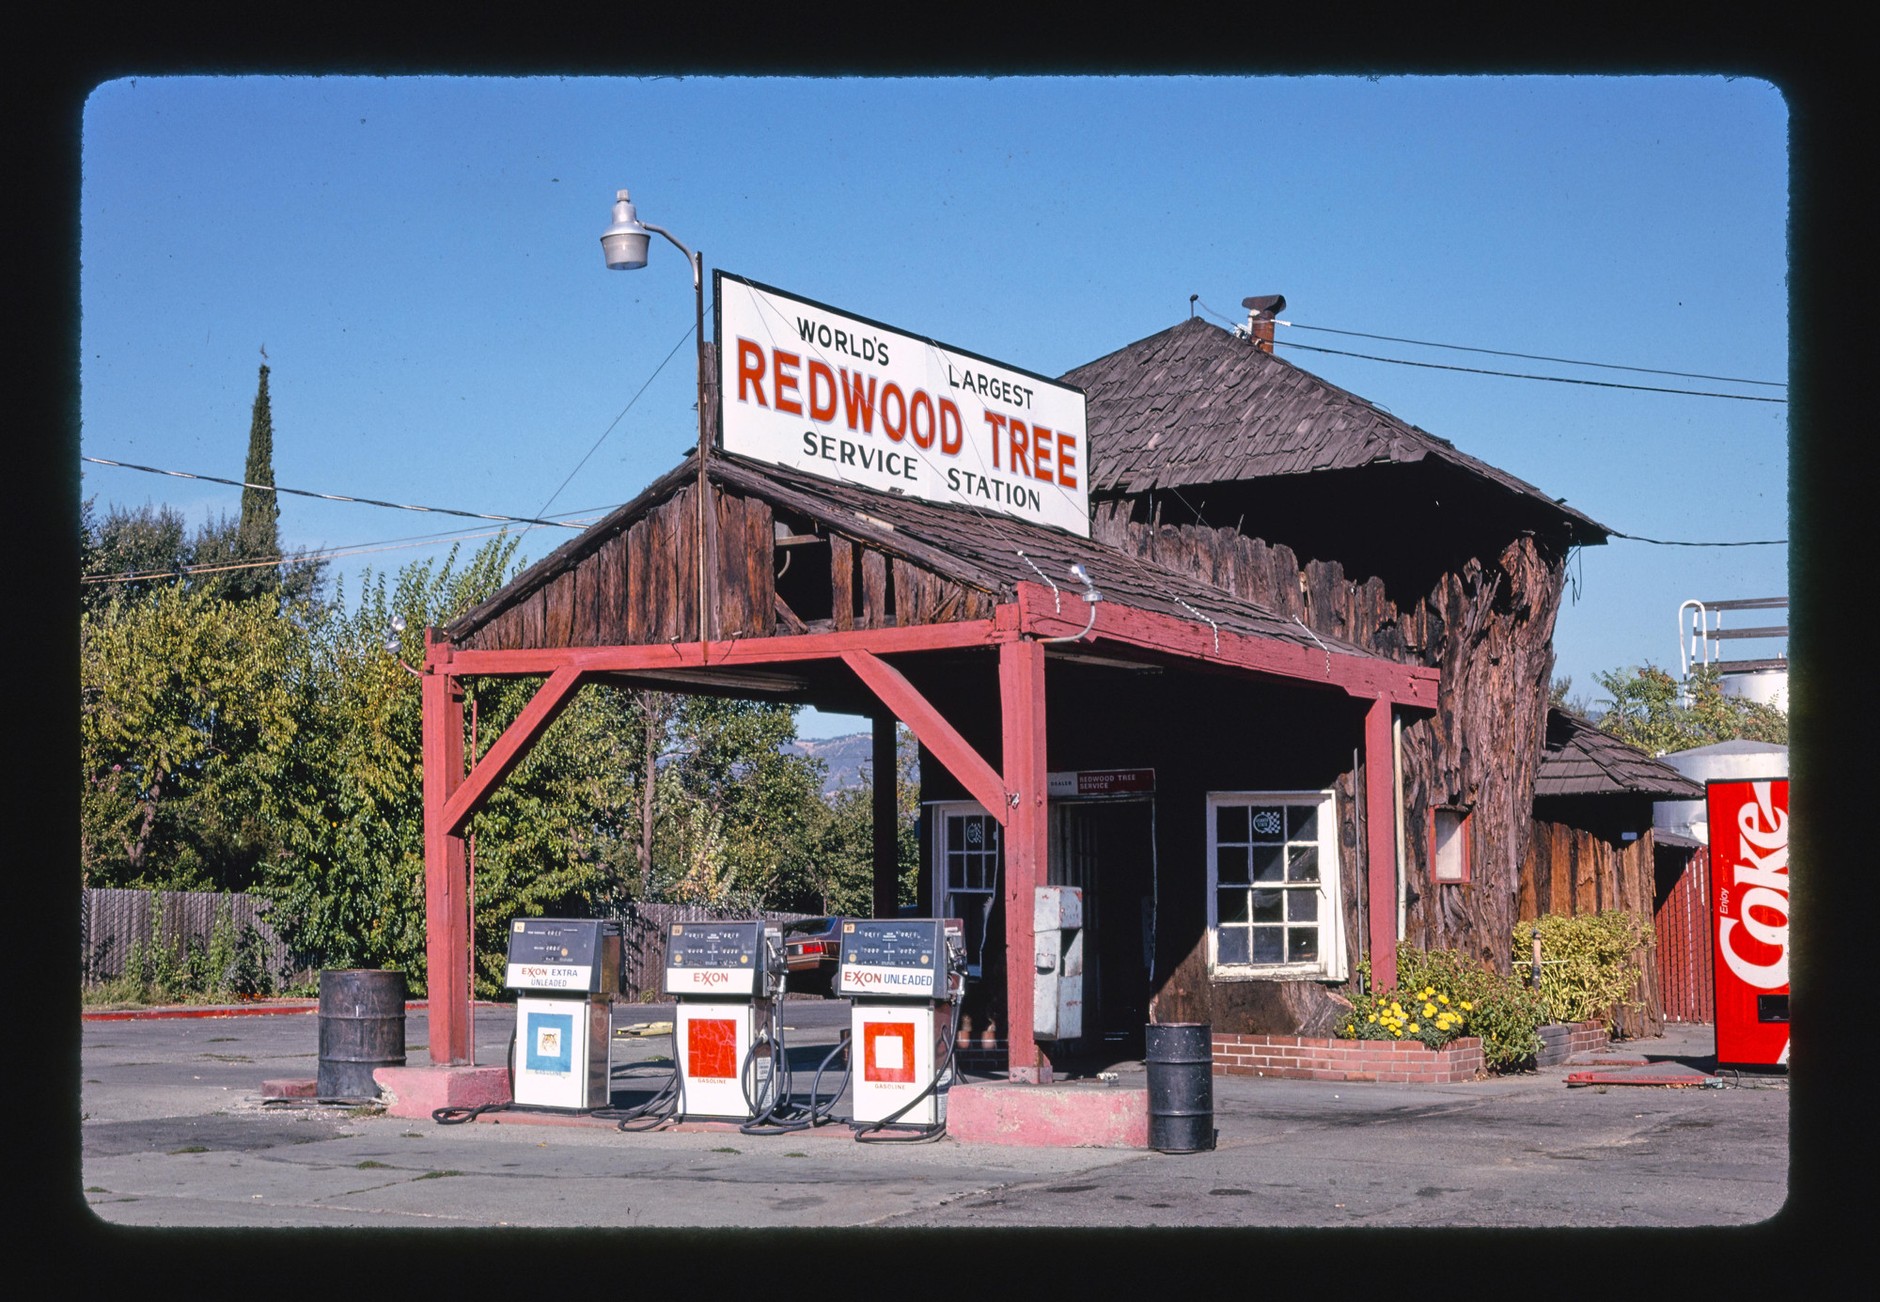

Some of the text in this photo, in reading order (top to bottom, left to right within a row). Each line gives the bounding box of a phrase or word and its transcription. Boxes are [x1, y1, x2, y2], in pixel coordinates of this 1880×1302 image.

[797, 317, 1033, 409] WORLD'S LARGEST
[736, 336, 1078, 489] REDWOOD TREE
[803, 431, 1041, 513] SERVICE STATION
[1080, 775, 1115, 783] REDWOOD
[1719, 782, 1789, 989] Coke
[1719, 887, 1730, 914] Enjoy
[521, 967, 578, 978] EXXON EXTRA
[531, 979, 567, 987] UNLEADED
[693, 971, 729, 987] EXXON
[844, 970, 933, 987] EXXON UNLEADED
